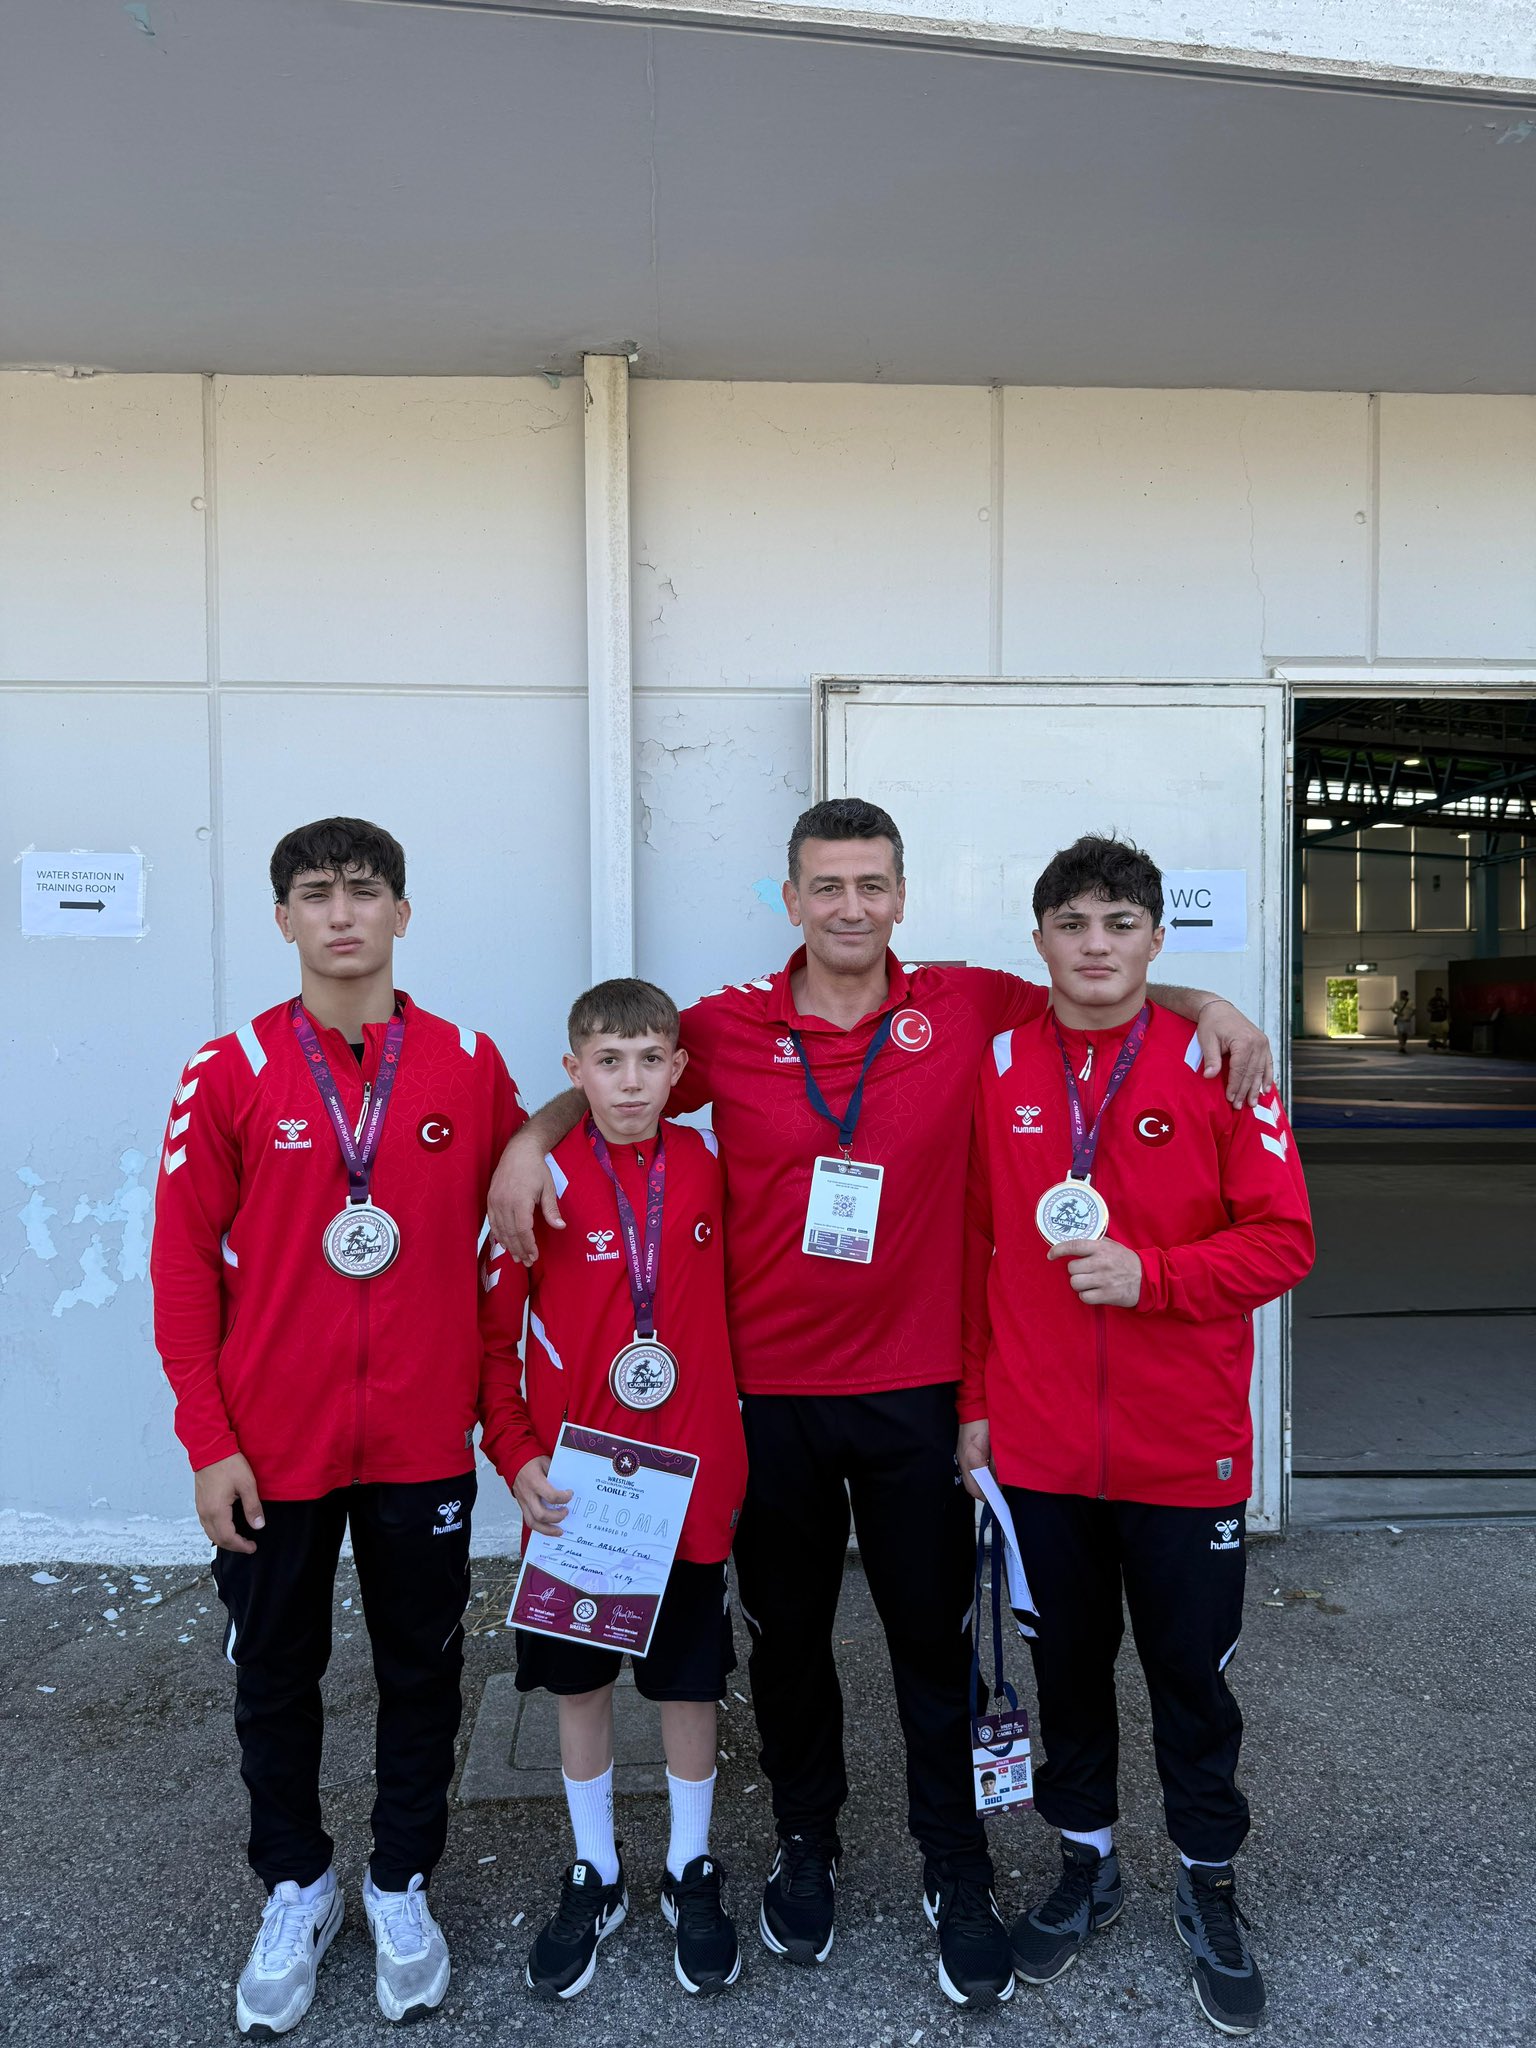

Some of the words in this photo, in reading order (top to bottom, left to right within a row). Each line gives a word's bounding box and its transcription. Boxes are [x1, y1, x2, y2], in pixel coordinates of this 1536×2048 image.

[36, 870, 70, 880] WATER
[71, 871, 112, 881] STATION
[113, 872, 124, 881] IN
[36, 883, 83, 892] TRAINING
[85, 884, 116, 893] ROOM
[1169, 889, 1212, 909] WC
[773, 1054, 801, 1064] humme
[1012, 1124, 1043, 1134] hummel
[274, 1138, 312, 1149] hummel
[586, 1249, 620, 1262] hummel
[596, 1484, 627, 1497] CAORLE
[571, 1496, 669, 1538] IPLOMA
[433, 1519, 462, 1535] hummel
[1210, 1538, 1240, 1550] hummel
